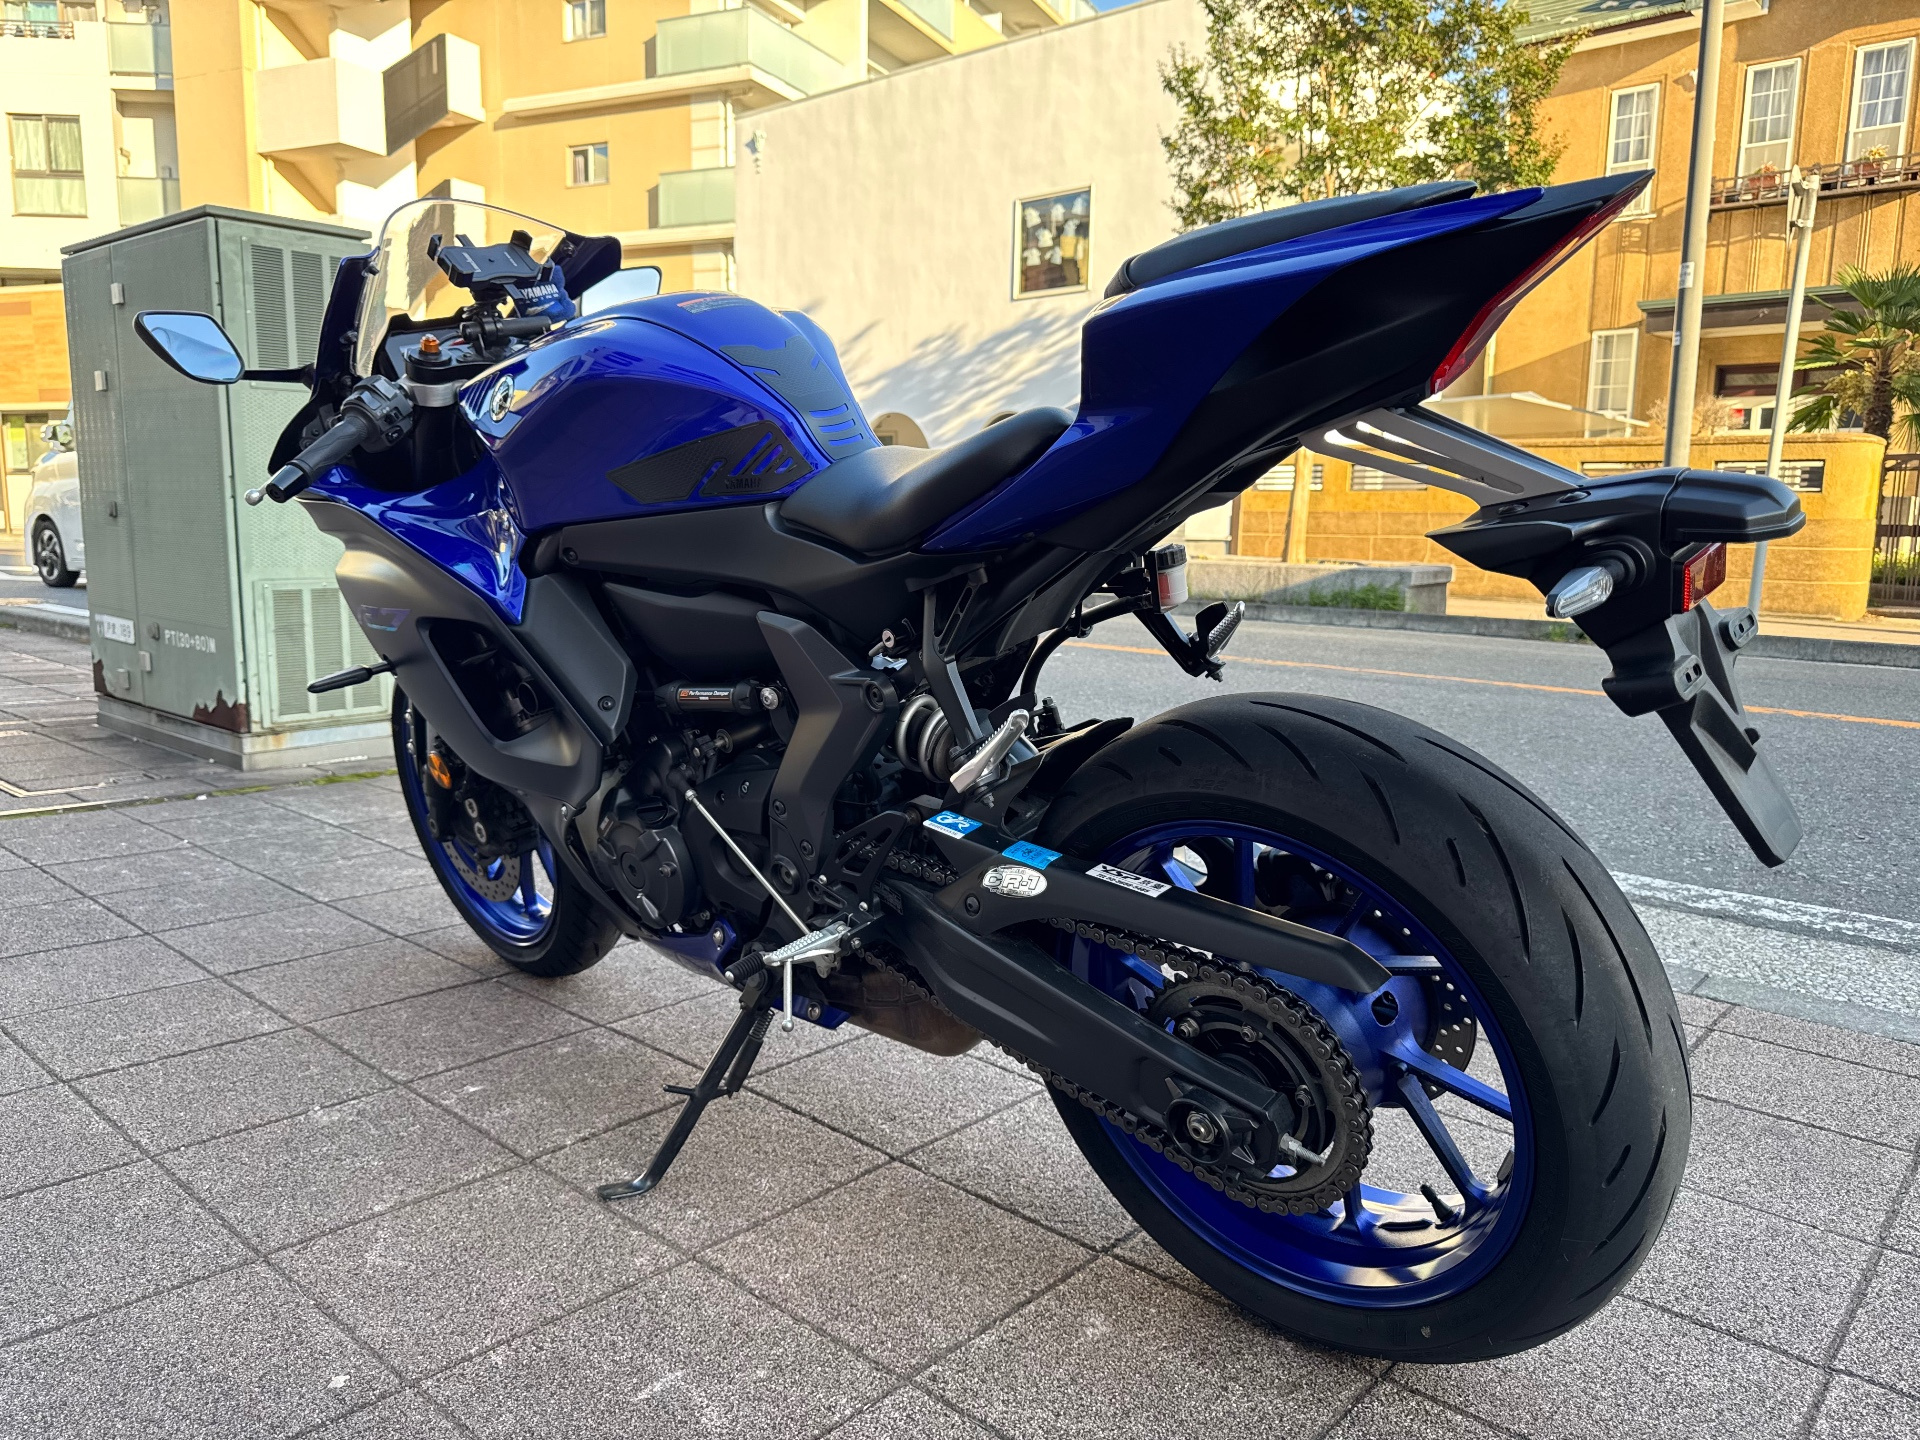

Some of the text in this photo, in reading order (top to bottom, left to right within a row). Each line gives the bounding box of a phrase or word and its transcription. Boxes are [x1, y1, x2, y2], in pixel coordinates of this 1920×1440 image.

[521, 284, 559, 300] YAMAHA
[725, 477, 762, 490] YAMAHA
[1101, 865, 1141, 880] YSP
[983, 872, 1040, 890] CR-1
